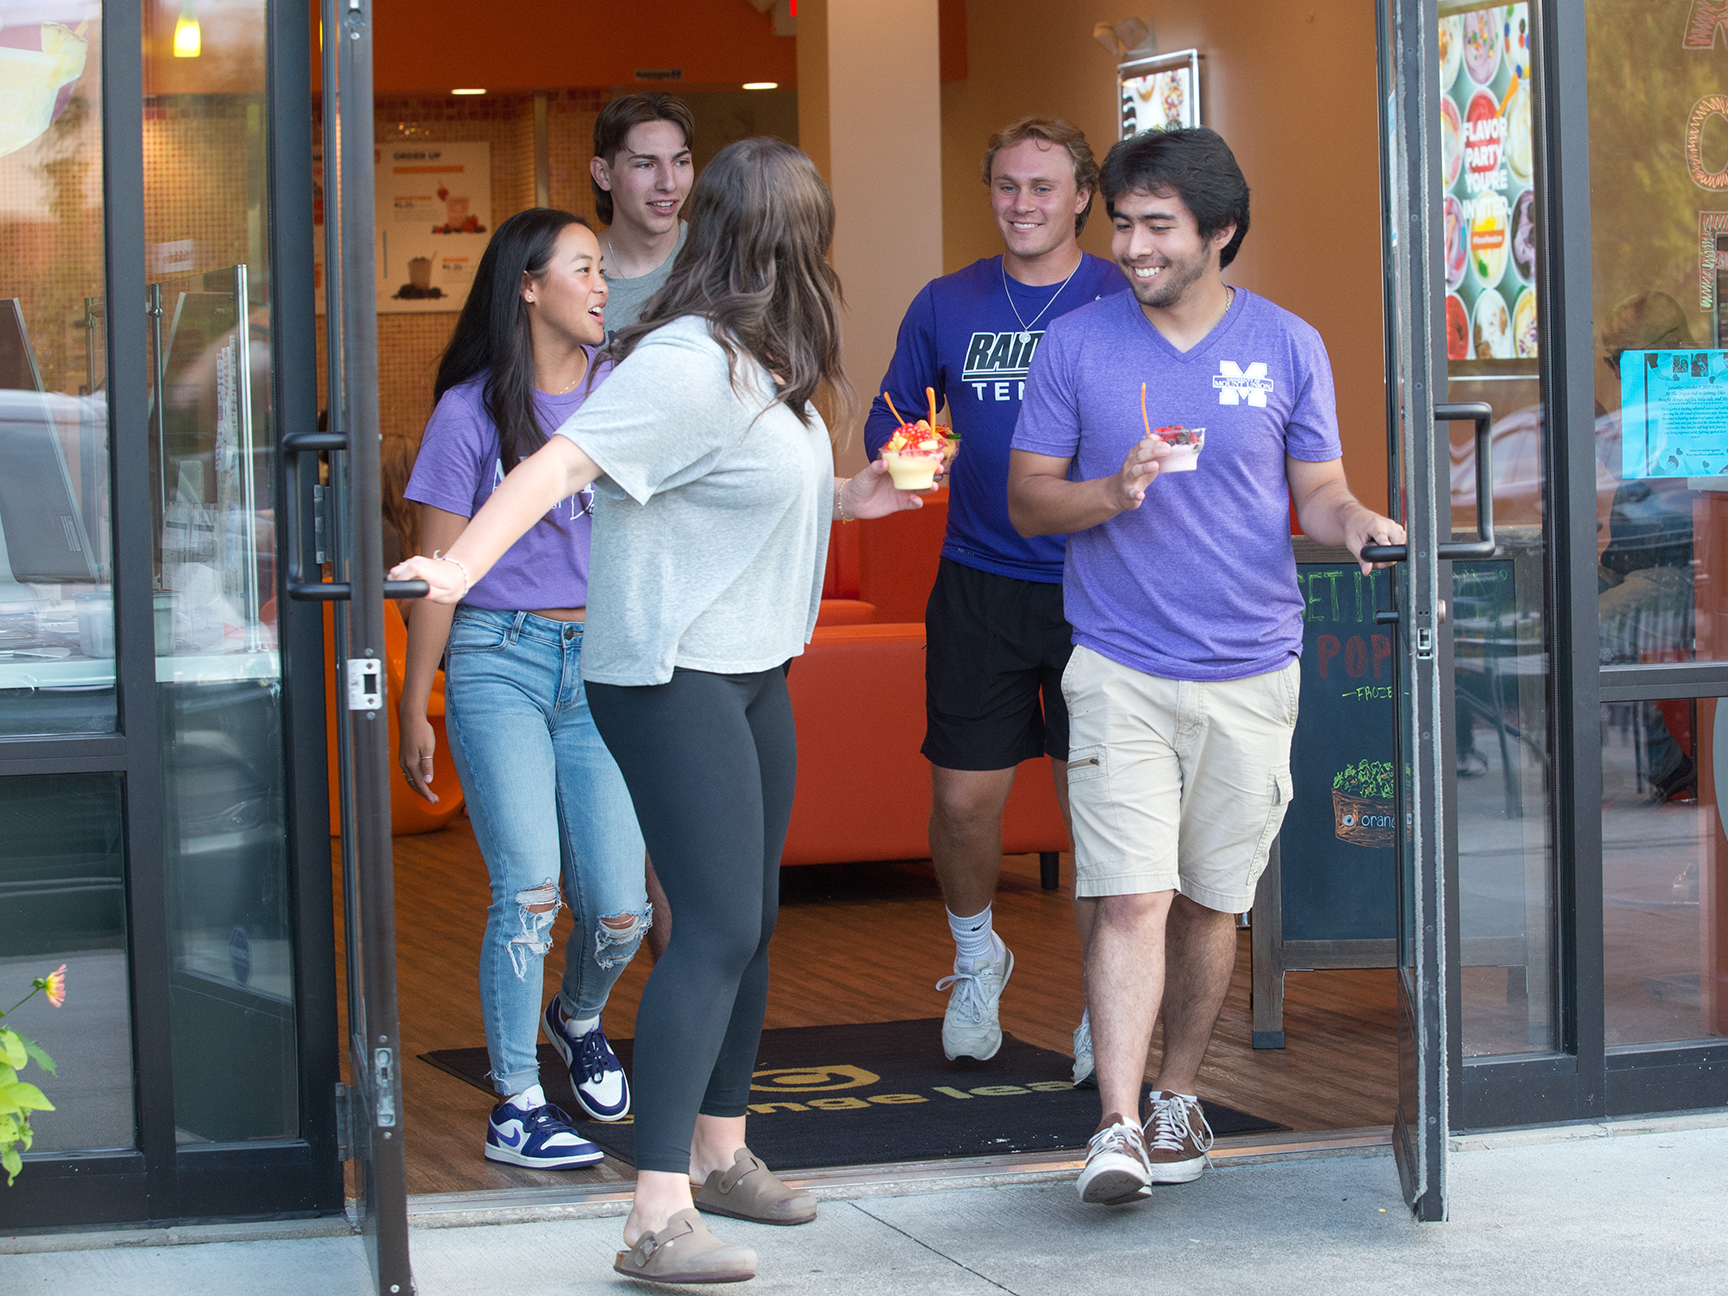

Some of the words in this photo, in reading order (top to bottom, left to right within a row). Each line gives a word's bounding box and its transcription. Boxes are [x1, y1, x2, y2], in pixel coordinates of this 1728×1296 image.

[1463, 117, 1508, 142] FLAVOR
[393, 152, 426, 161] ORDER
[428, 152, 441, 161] UP
[1464, 144, 1506, 167] PARTY.
[1463, 196, 1512, 220] INVITED.
[1297, 571, 1343, 622] ET
